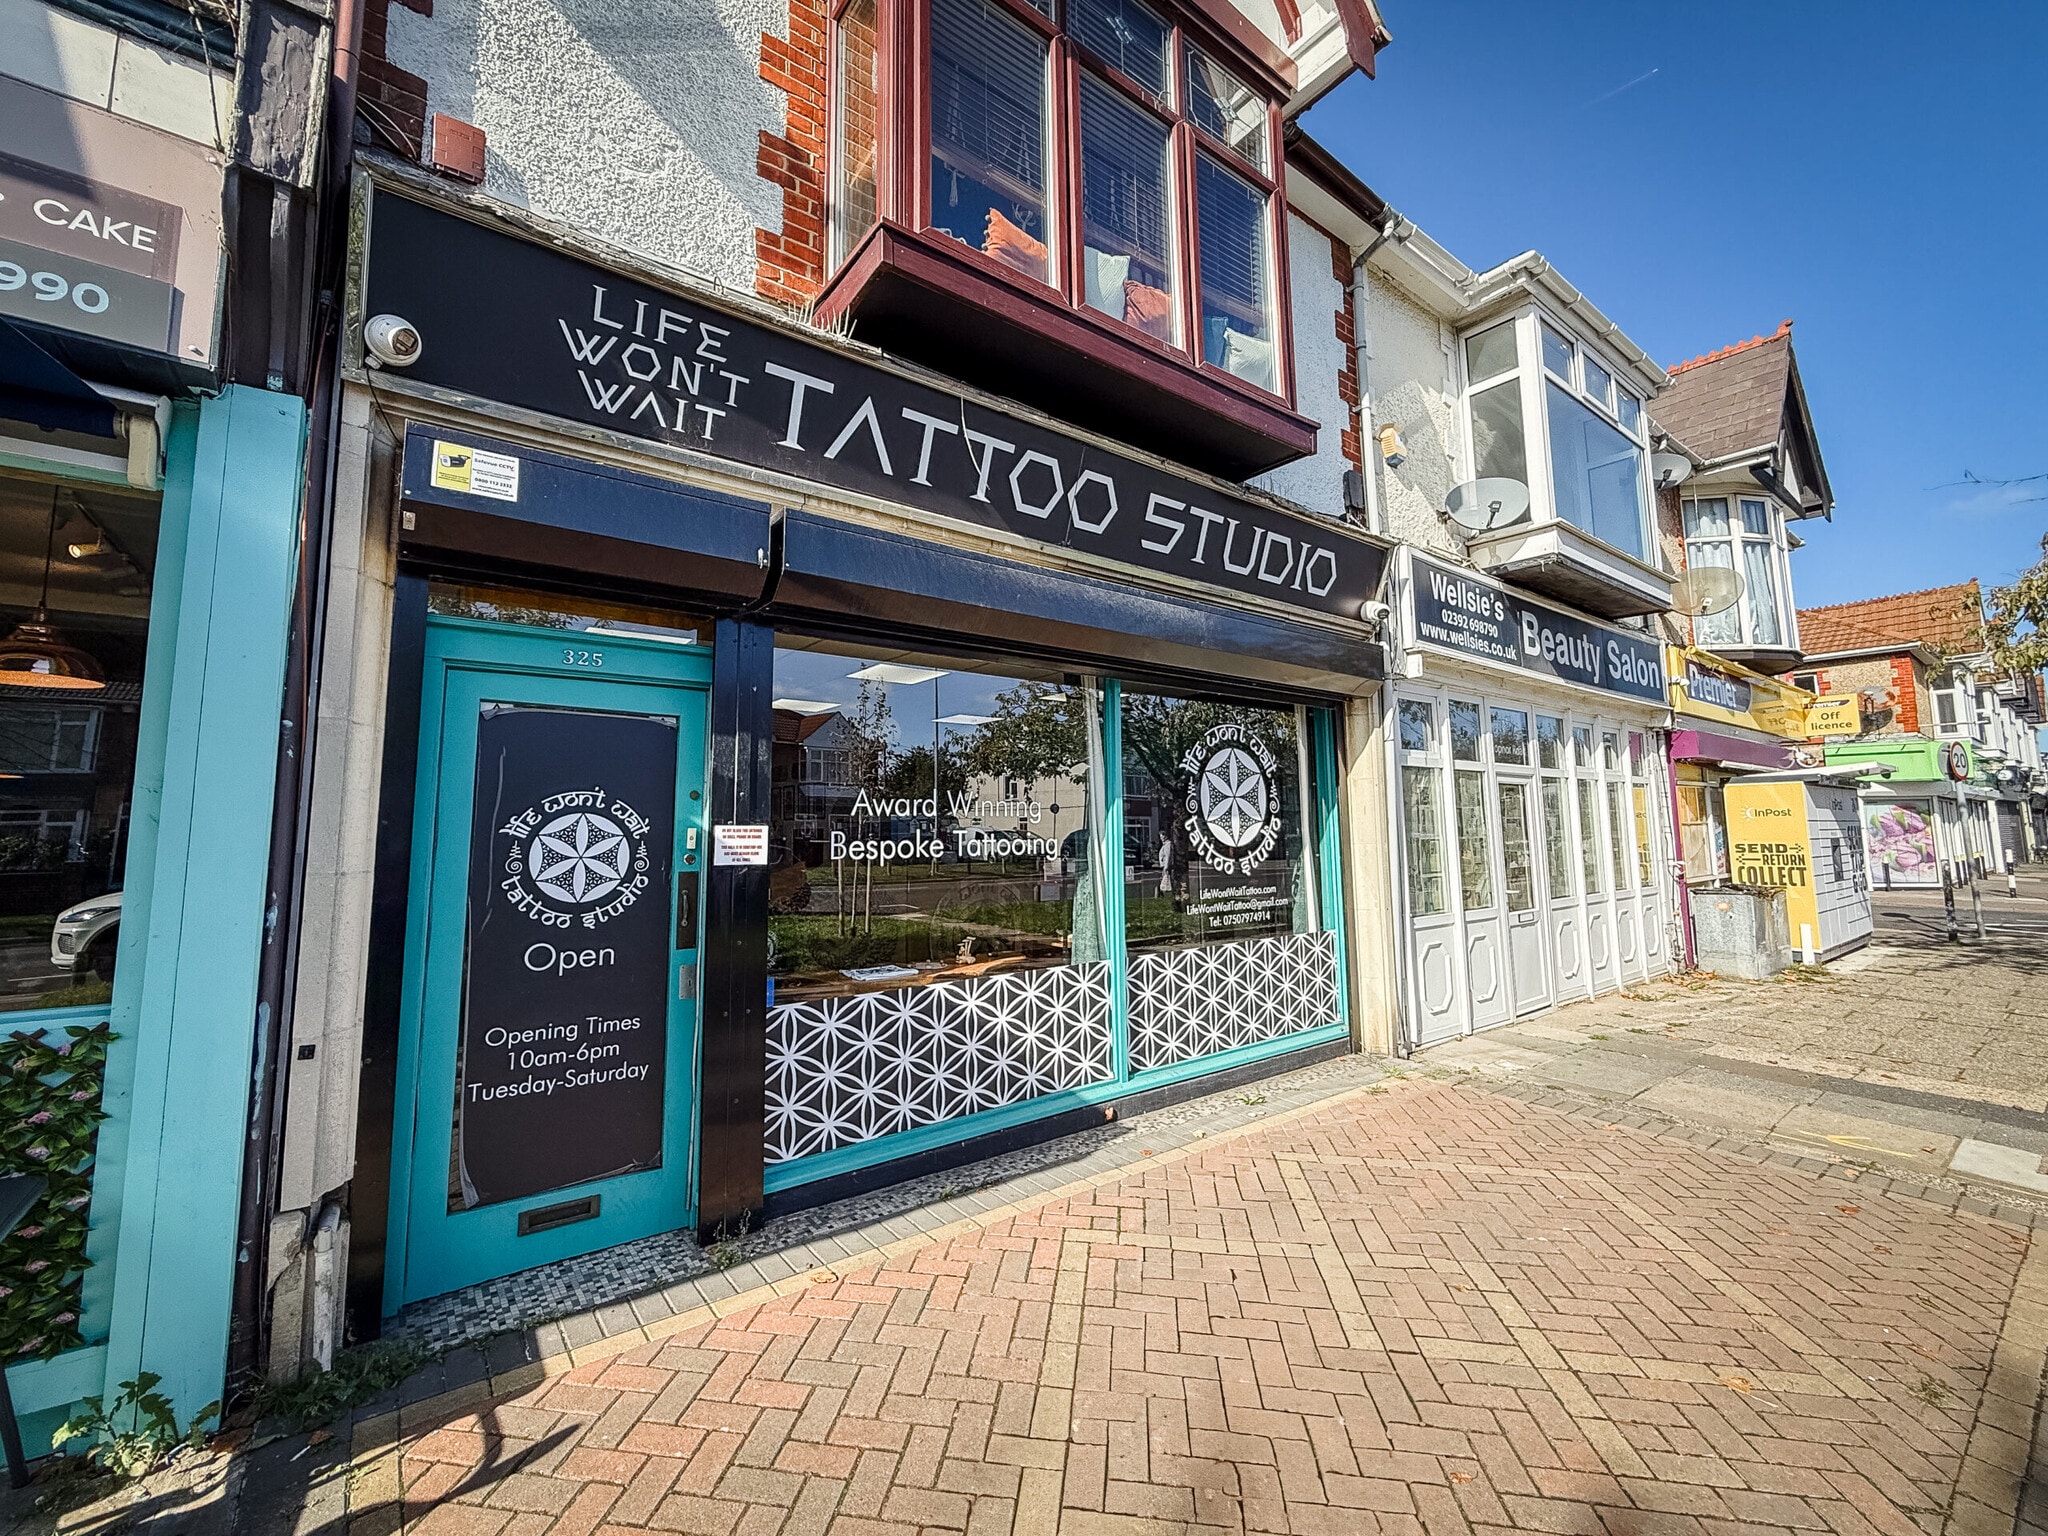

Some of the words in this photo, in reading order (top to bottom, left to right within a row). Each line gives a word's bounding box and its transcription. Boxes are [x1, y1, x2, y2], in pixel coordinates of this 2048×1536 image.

[33, 198, 157, 254] CAKE
[592, 285, 731, 363] LIFE
[558, 318, 750, 407] WON'T
[578, 370, 727, 441] WAIT
[764, 361, 1119, 535] TATTOO
[1140, 492, 1338, 597] STUDIO
[1429, 570, 1504, 622] Wellsie's
[1441, 608, 1468, 631] 02392
[1469, 619, 1498, 639] 698790
[562, 650, 603, 667] 325
[1420, 621, 1517, 662] www.wellsies.co.uk
[1522, 609, 1601, 684] Beauty
[1607, 639, 1661, 690] Salon
[1688, 663, 1737, 708] Premier
[1811, 721, 1853, 731] licence
[1821, 711, 1841, 721] Off
[1953, 752, 1967, 769] 20
[850, 787, 938, 818] Award
[947, 790, 1042, 823] Winning
[1755, 808, 1792, 817] InPost
[830, 828, 945, 867] Bespoke
[953, 829, 1059, 861] Tattooing
[1734, 843, 1788, 854] SEND
[1762, 854, 1806, 866] RETURN
[1737, 866, 1807, 887] COLLECT
[501, 874, 573, 929] tattoo
[580, 872, 650, 930] studio
[1208, 916, 1222, 928] Tel:
[524, 943, 615, 977] Open
[485, 1023, 578, 1049] Opening
[585, 1016, 641, 1035] Times
[508, 1042, 620, 1071] 10am-6pm
[468, 1060, 649, 1103] Tuesday-Saturday
